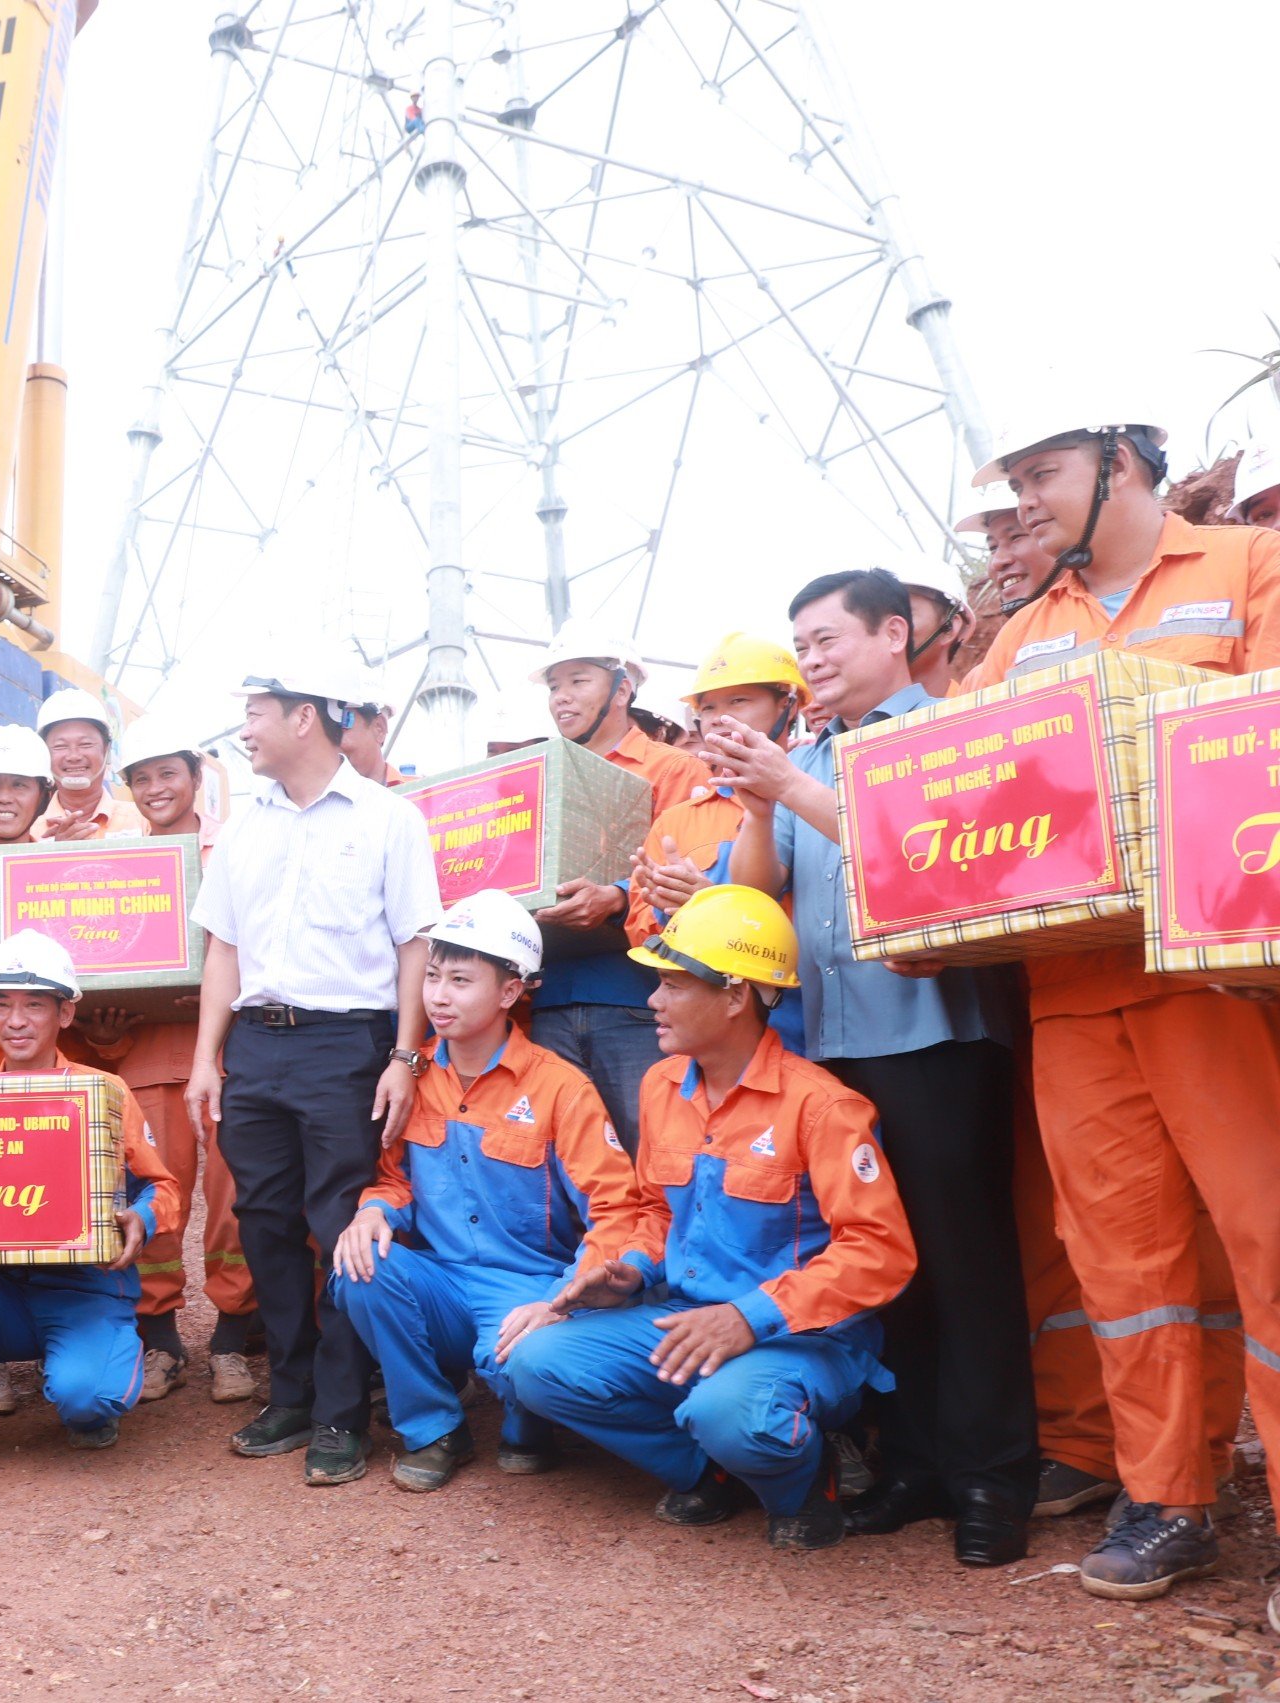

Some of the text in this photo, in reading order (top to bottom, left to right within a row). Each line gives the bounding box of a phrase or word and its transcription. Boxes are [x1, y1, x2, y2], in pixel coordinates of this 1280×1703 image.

[864, 763, 894, 788] TỈNH
[964, 732, 1009, 759] UBND-
[1011, 713, 1074, 746] UBMTTQ
[1188, 735, 1228, 765] TỈNH
[921, 760, 1017, 802] TỈNH NGHỆ AN
[444, 823, 483, 851] MINH
[486, 809, 532, 840] CHÍNH
[901, 813, 1059, 873] Tặng
[441, 856, 485, 876] Tặng
[17, 892, 172, 923] PHẠM MINH CHÍNH
[68, 924, 120, 944] Tặng
[726, 938, 760, 956] SÔNG
[23, 1115, 70, 1132] UBMTTQ
[6, 1140, 24, 1155] AN
